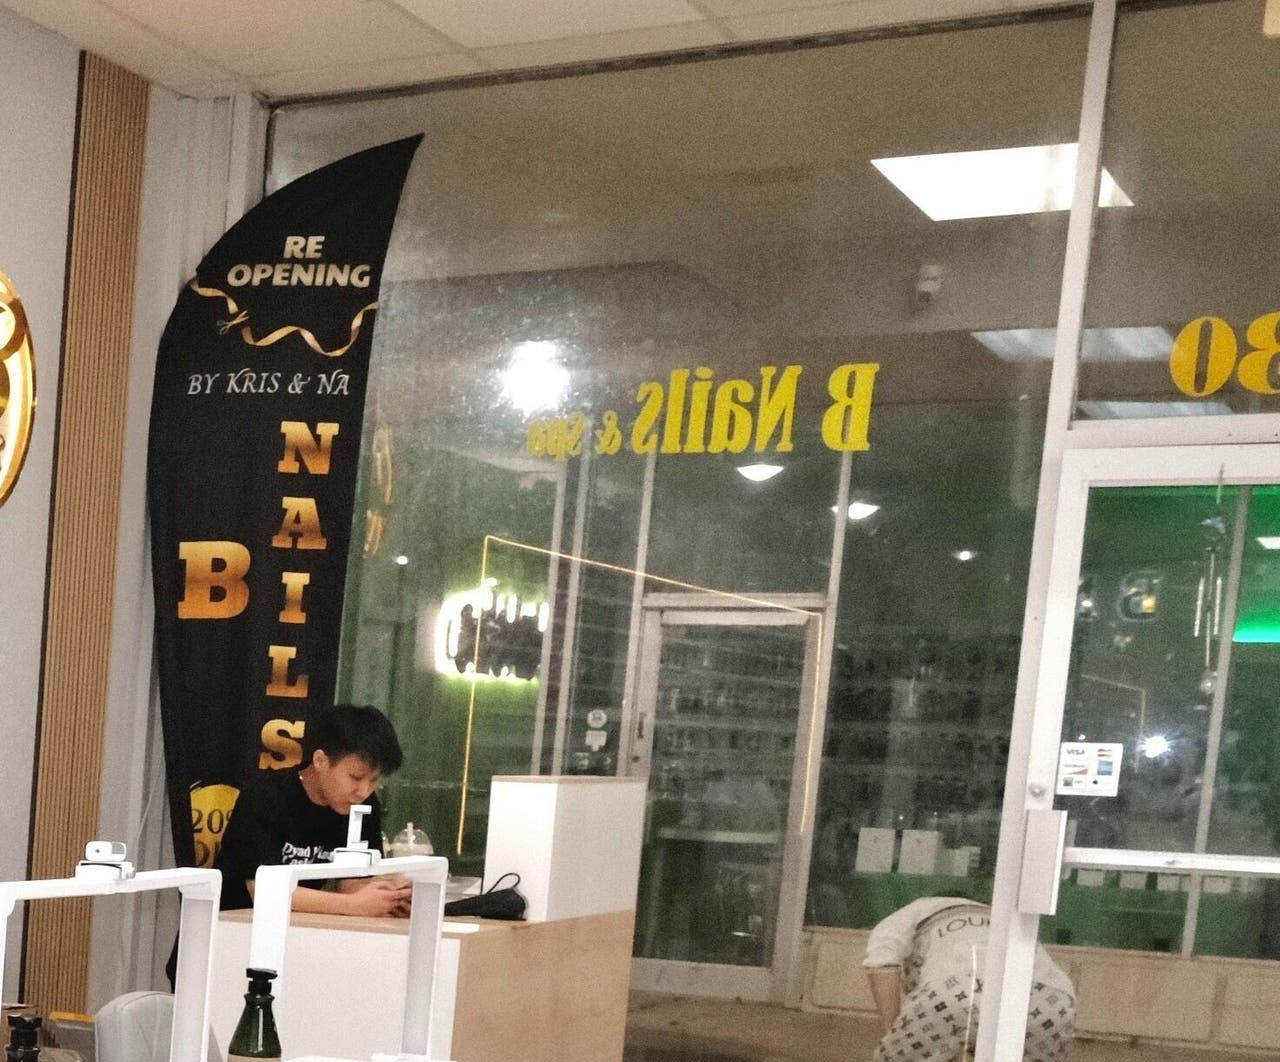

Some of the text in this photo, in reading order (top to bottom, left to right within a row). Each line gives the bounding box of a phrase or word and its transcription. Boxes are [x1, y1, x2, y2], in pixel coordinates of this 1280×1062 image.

[283, 235, 325, 259] RE
[227, 263, 371, 288] OPENING
[187, 368, 350, 395] BY KRIS & NA
[178, 541, 251, 619] B
[259, 421, 340, 770] NAILS
